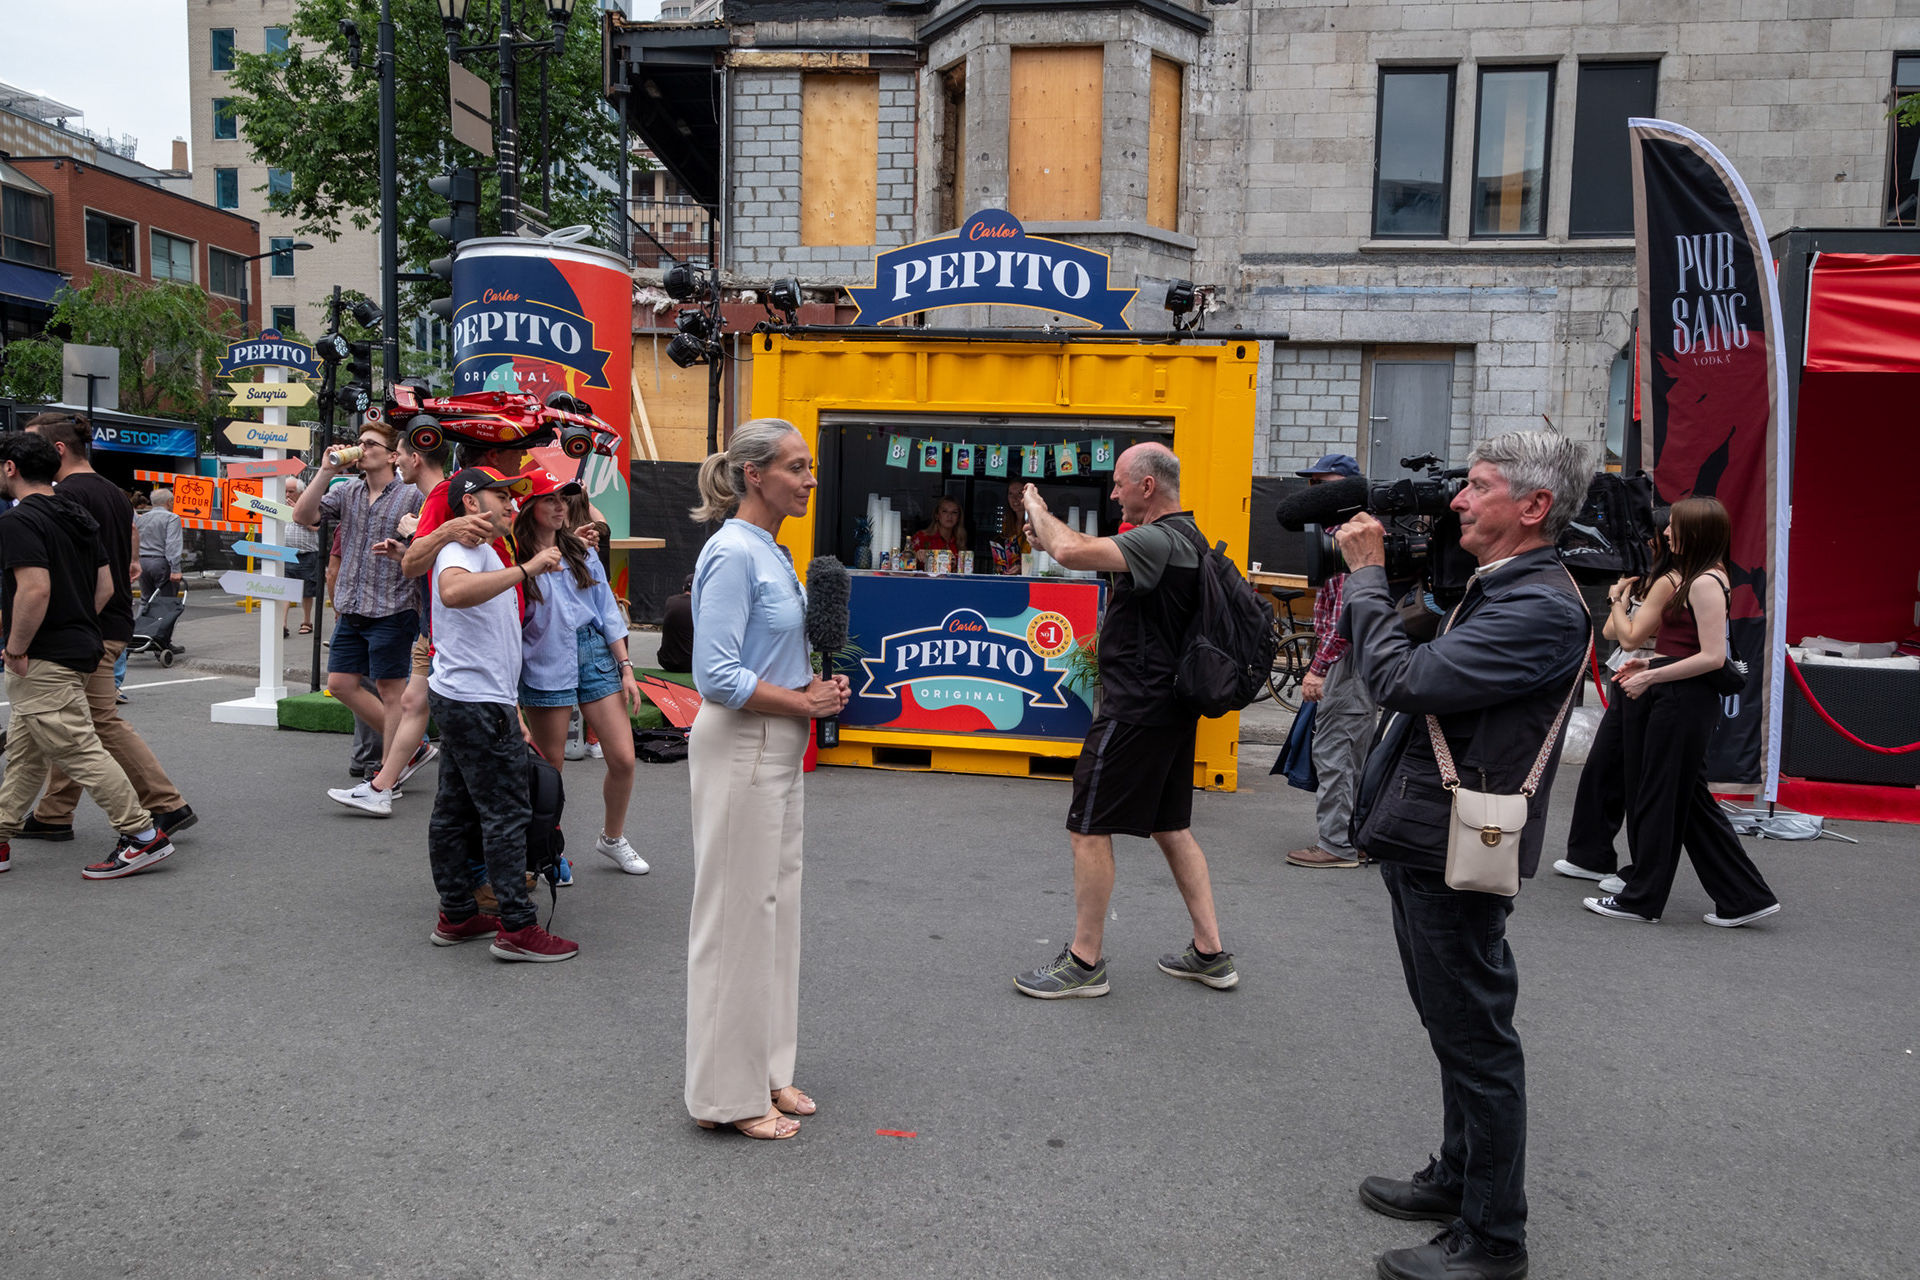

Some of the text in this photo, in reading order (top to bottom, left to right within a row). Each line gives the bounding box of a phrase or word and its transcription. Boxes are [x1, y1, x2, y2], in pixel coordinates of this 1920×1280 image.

[969, 221, 1019, 241] Carlos
[1675, 231, 1737, 293] PUR
[892, 250, 1091, 301] PEPITO
[482, 288, 520, 304] Carlos
[1672, 292, 1750, 355] SANG
[261, 333, 280, 341] Carlos
[453, 311, 582, 358] PEPITO
[233, 343, 307, 364] PEPITO
[1693, 354, 1731, 367] VODKA
[464, 371, 550, 383] ORIGINAL
[246, 387, 288, 403] Sangria
[91, 427, 169, 446] AP STORE
[246, 428, 289, 445] Original
[892, 444, 906, 459] 8$
[990, 453, 1004, 469] 8$
[175, 495, 210, 507] DÉTOUR
[250, 499, 279, 515] Blanca
[246, 581, 286, 596] Madrid
[949, 619, 984, 633] Carlos
[895, 639, 1034, 677] PEPITO
[920, 689, 1005, 702] ORIGINAL
